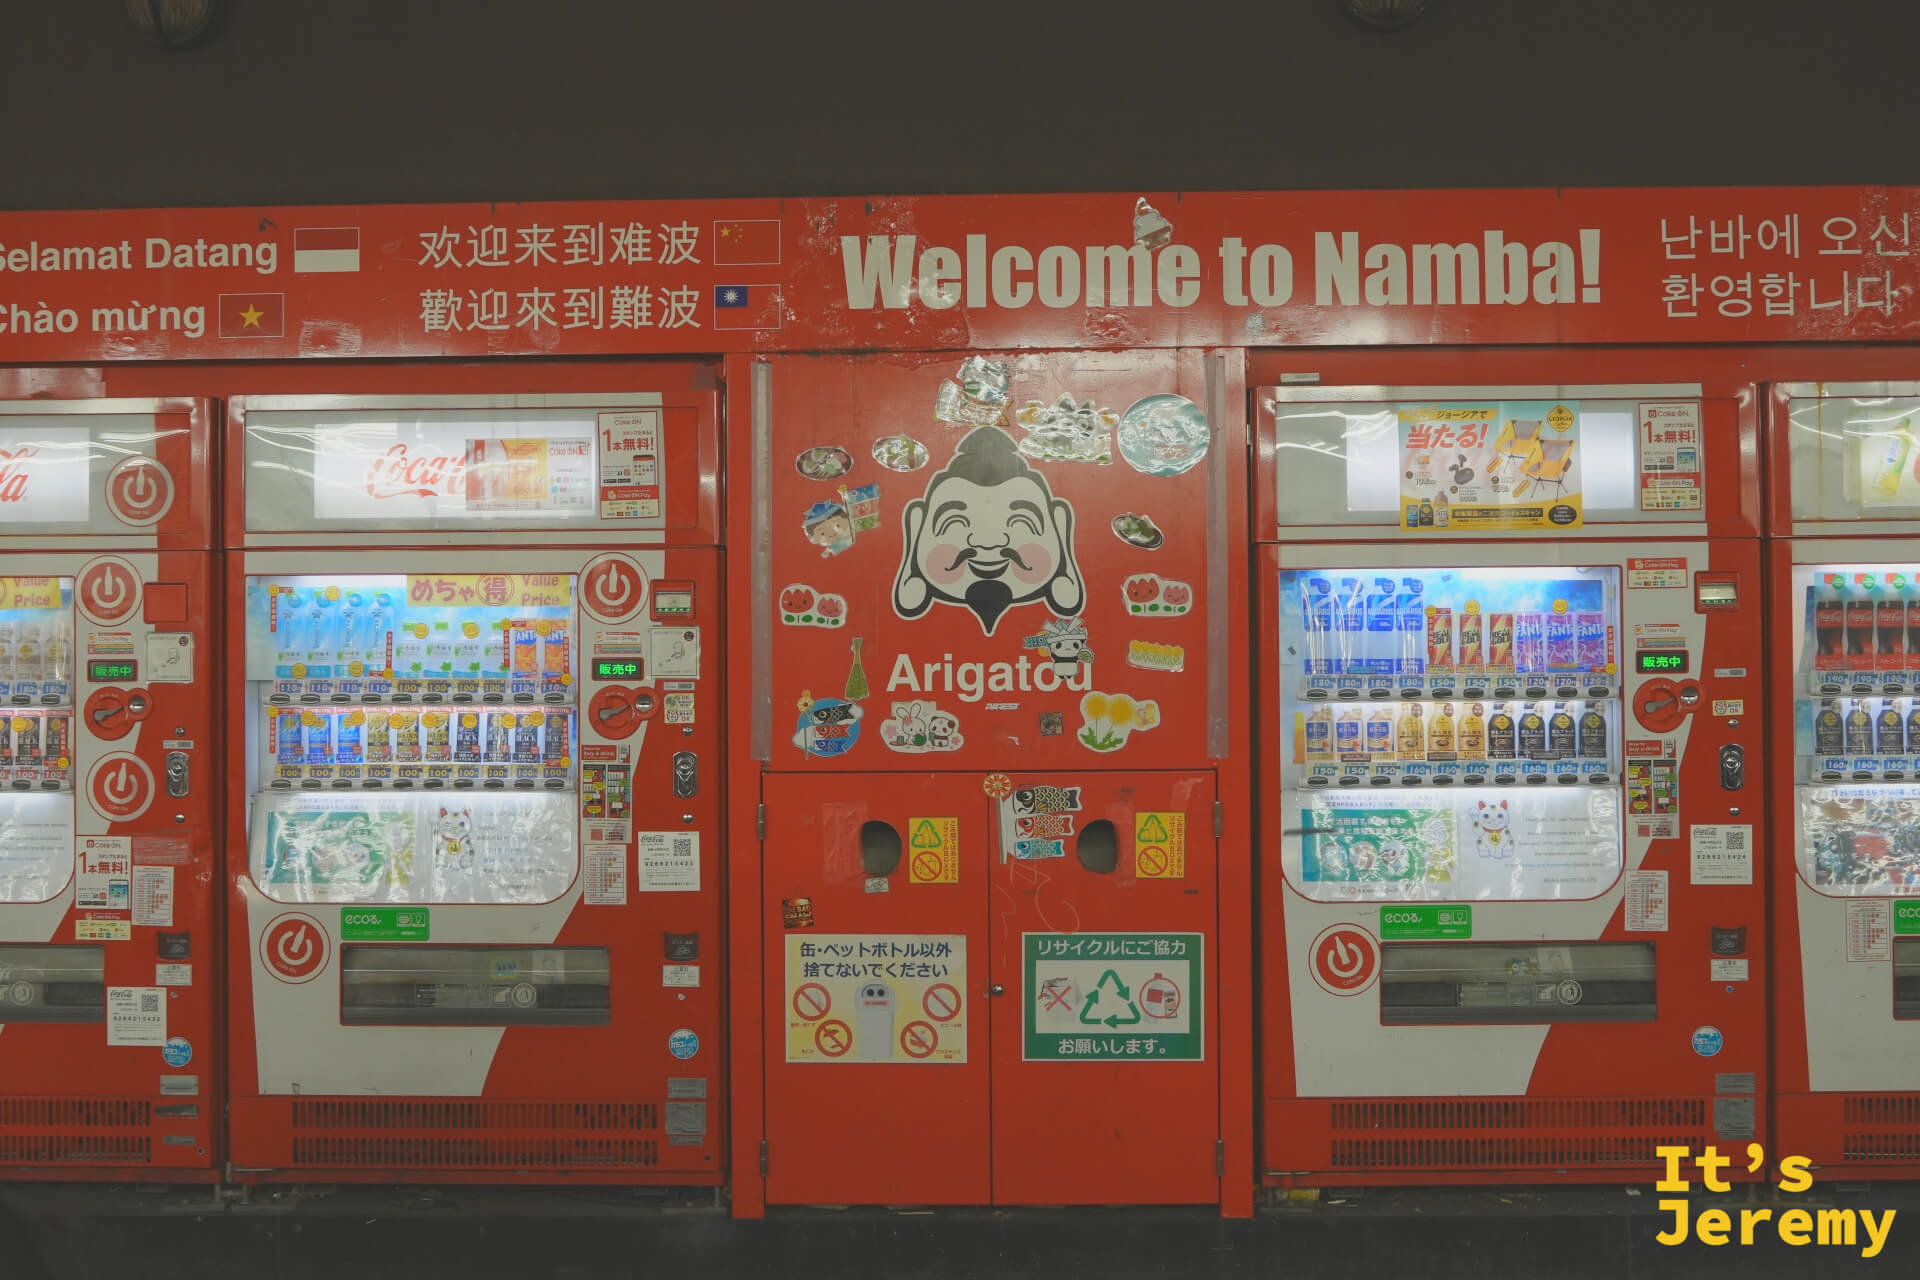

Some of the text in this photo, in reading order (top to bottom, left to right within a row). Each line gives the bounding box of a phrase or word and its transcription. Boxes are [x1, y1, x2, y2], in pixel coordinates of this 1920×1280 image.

[418, 220, 701, 270] 欢迎来到难波
[1660, 212, 1911, 260] 난바에 오신
[0, 238, 277, 274] elamat Datang
[840, 228, 1601, 310] Welcome to Namba!
[1661, 270, 1898, 318] 환영합니다
[418, 286, 702, 331] 歡迎來到難波
[0, 301, 205, 338] hào mừng
[1436, 410, 1488, 419] ジョージアで
[1406, 424, 1489, 449] 当たる!
[14, 593, 49, 606] Price
[521, 591, 560, 606] Price
[599, 663, 637, 675] 販売中
[1642, 656, 1681, 668] 販売中
[886, 652, 1092, 703] Arigatou
[800, 942, 952, 958] 缶・ペットボトル以外
[1037, 939, 1187, 956] リサイクルにご協力
[803, 962, 948, 978] 捨てないでください
[1058, 1038, 1167, 1055] お願いします。
